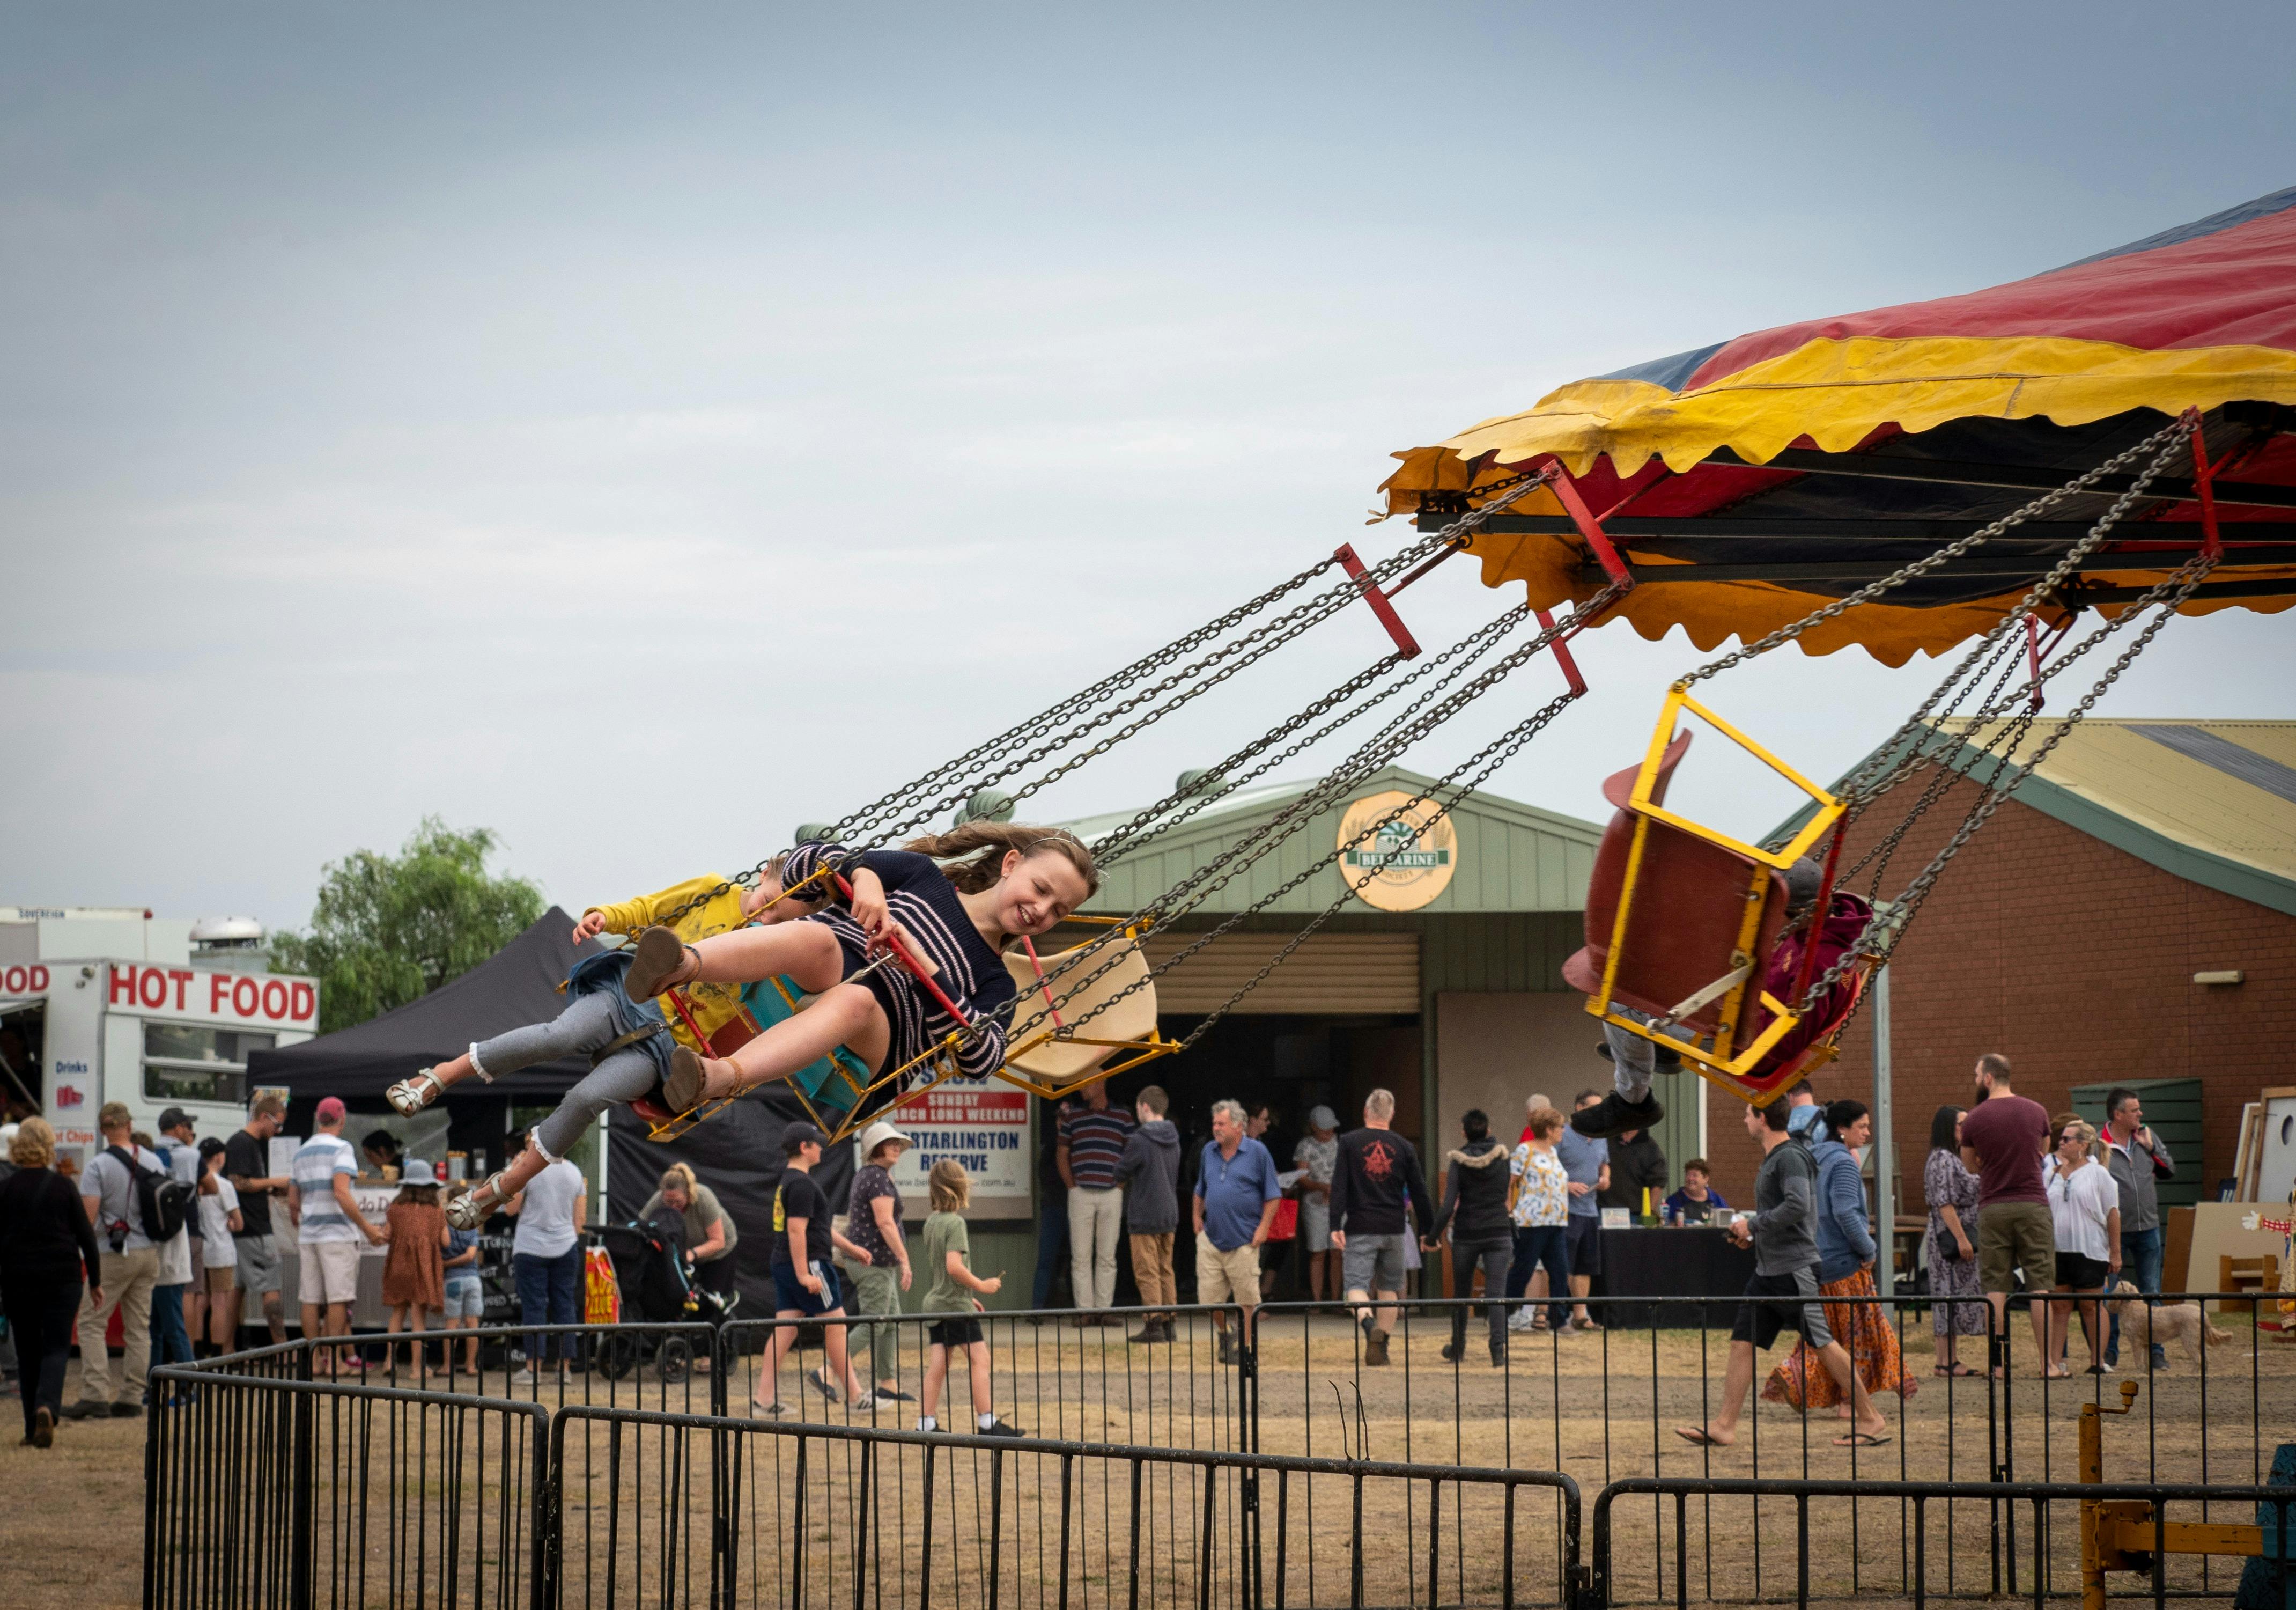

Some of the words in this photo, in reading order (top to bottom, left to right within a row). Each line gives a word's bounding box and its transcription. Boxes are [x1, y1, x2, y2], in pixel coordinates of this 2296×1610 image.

[1362, 854, 1435, 865] BELARINE
[0, 965, 50, 993] OD
[110, 965, 193, 1010] HOT
[211, 974, 316, 1021] FOOD
[56, 1061, 88, 1074] Drinks
[928, 1093, 980, 1107] SUNDAY
[895, 1108, 927, 1121] ARCH
[929, 1108, 964, 1121] LONG
[965, 1108, 1026, 1121] WEEKEND
[66, 1129, 94, 1145] Chips
[902, 1131, 1019, 1149] RTARLINGTON
